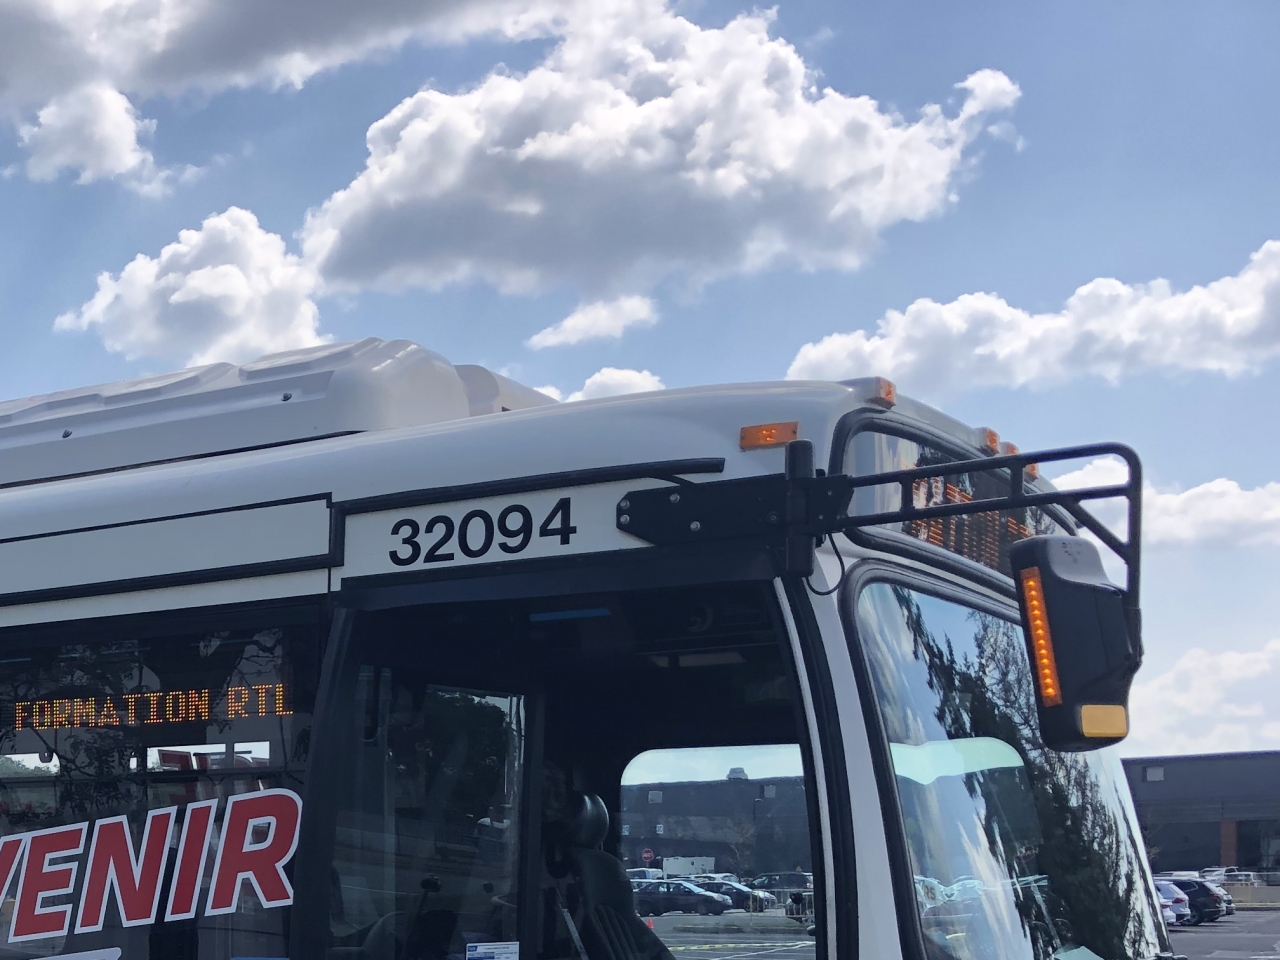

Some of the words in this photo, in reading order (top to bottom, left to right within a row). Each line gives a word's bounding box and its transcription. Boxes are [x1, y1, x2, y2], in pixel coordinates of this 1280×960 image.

[389, 497, 577, 566] 32094
[14, 686, 211, 730] FORMATION
[227, 682, 294, 719] RTL
